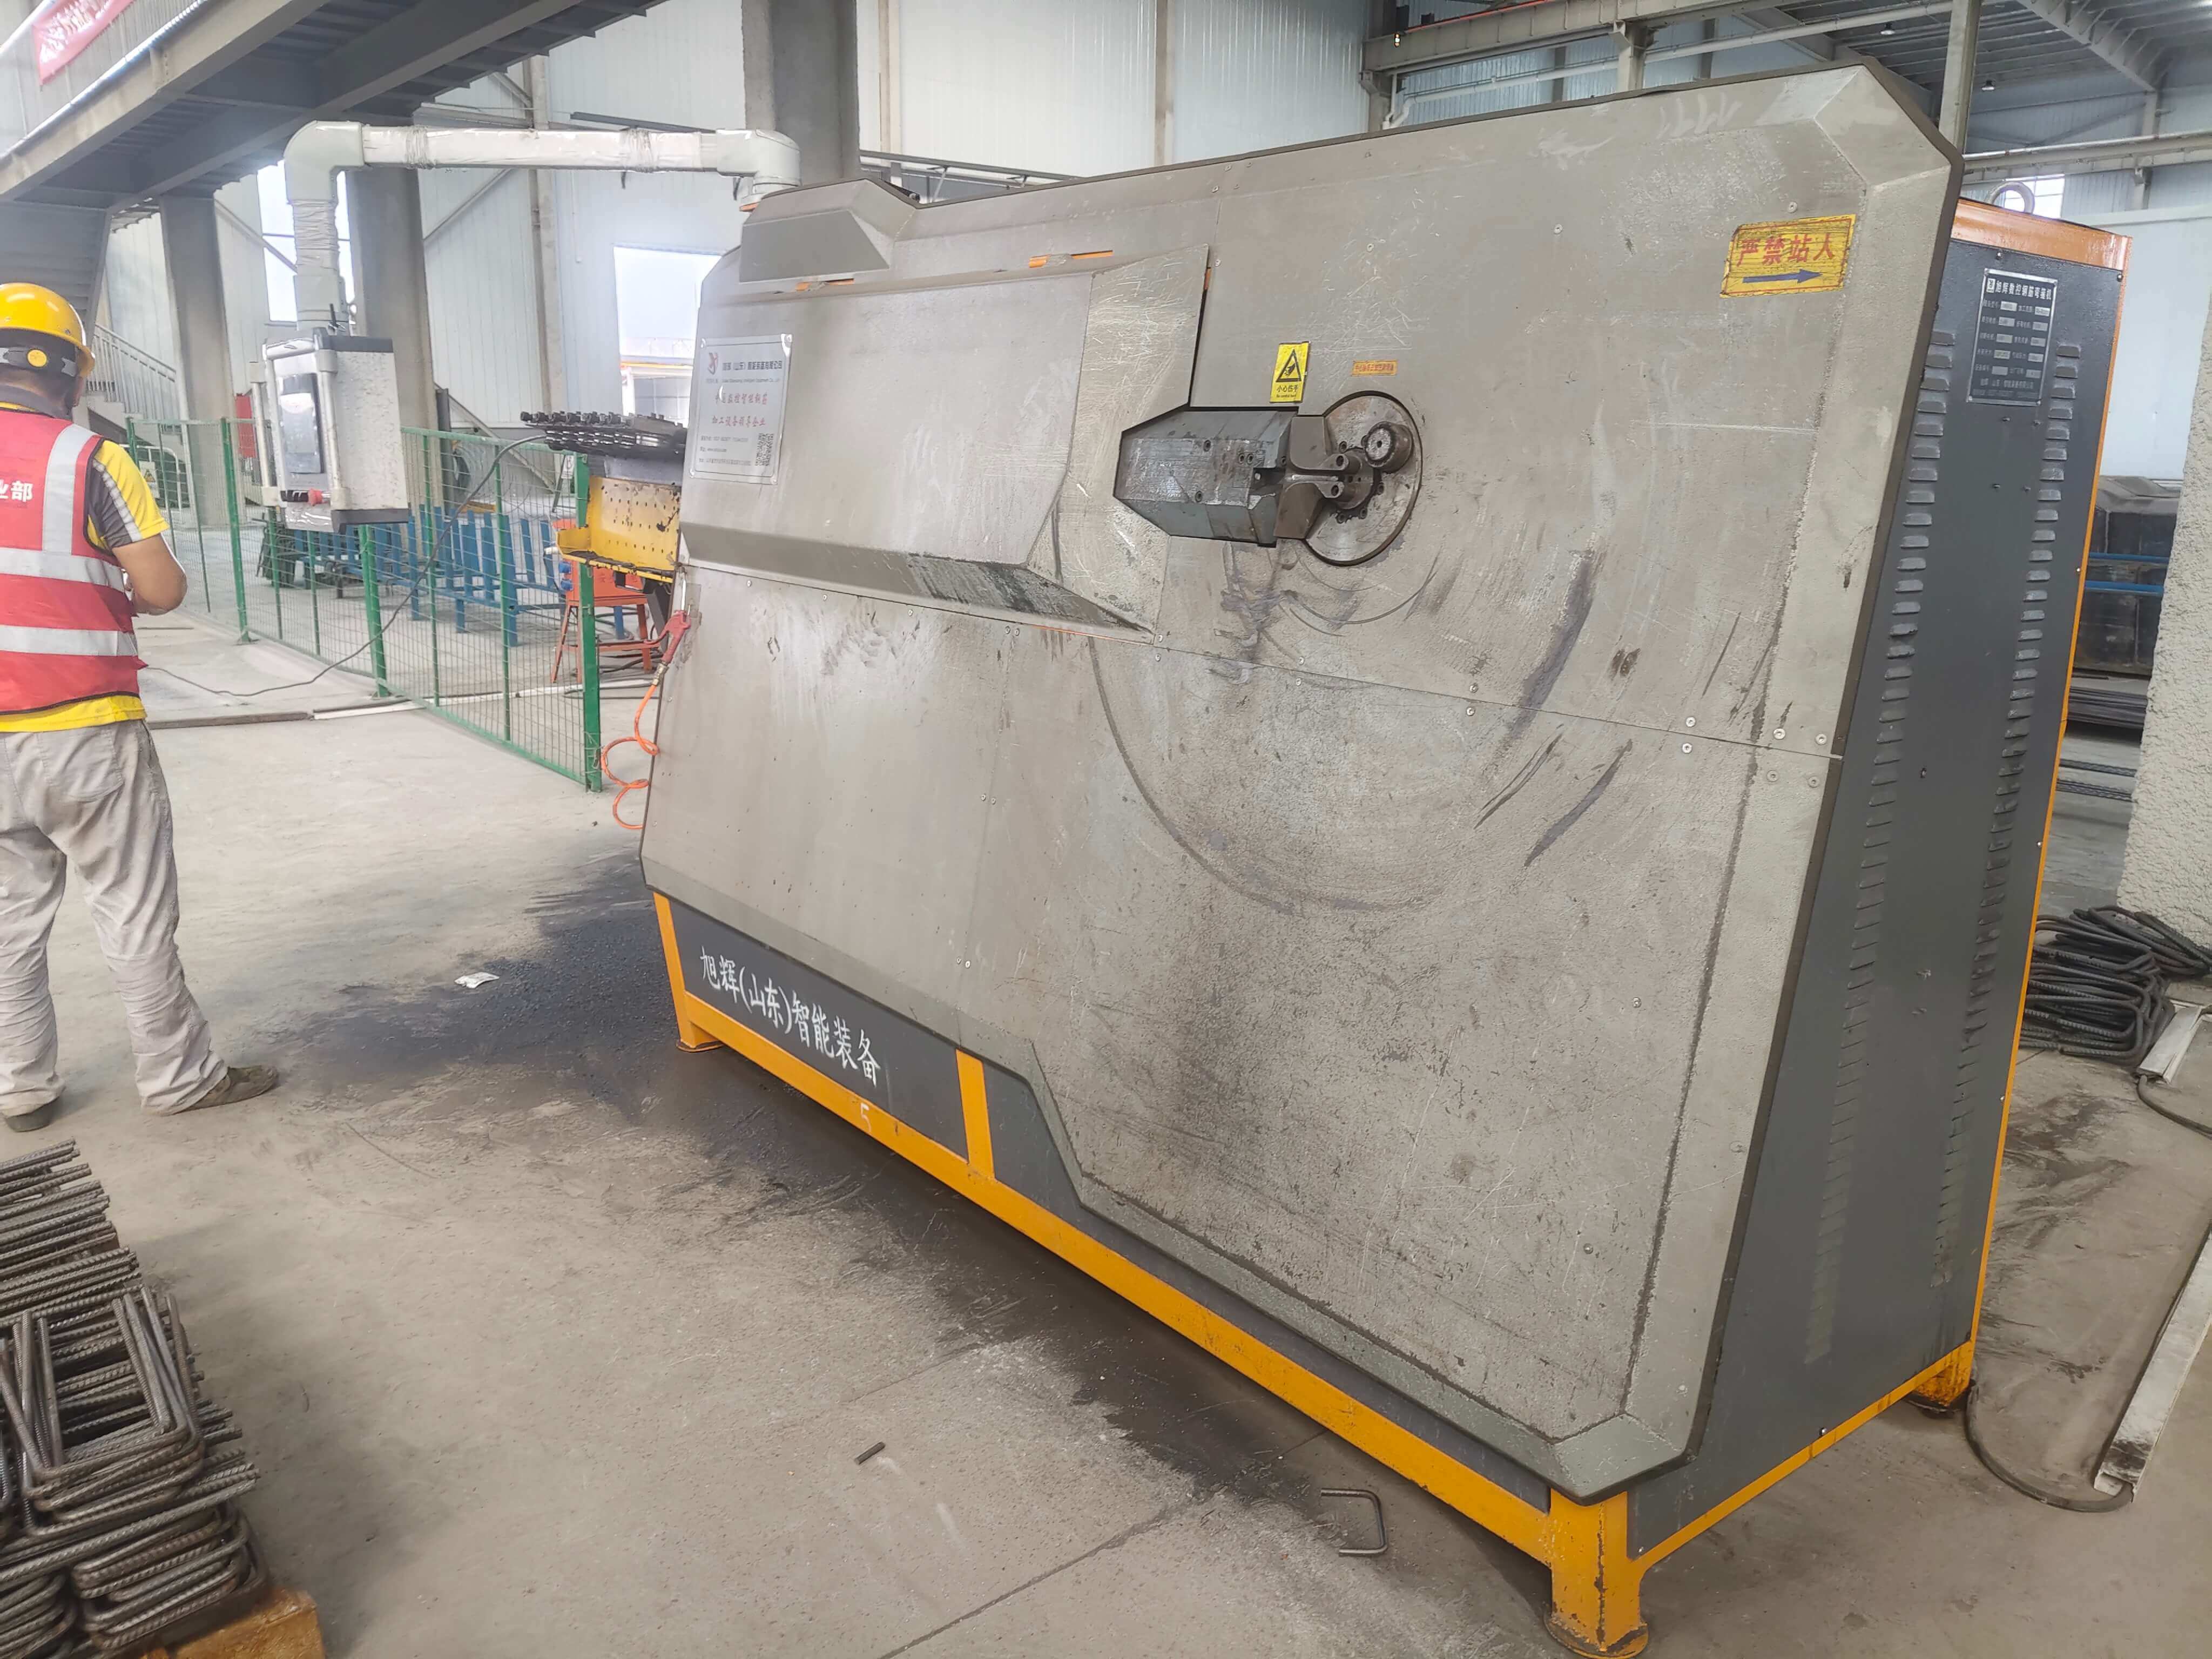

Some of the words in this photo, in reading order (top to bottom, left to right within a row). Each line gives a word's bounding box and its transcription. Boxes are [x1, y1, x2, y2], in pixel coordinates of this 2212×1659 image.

[1736, 233, 1835, 267] 严禁站人
[1277, 384, 1299, 393] 小心伤手
[700, 946, 881, 1088] 旭辉(山东)智能装备
